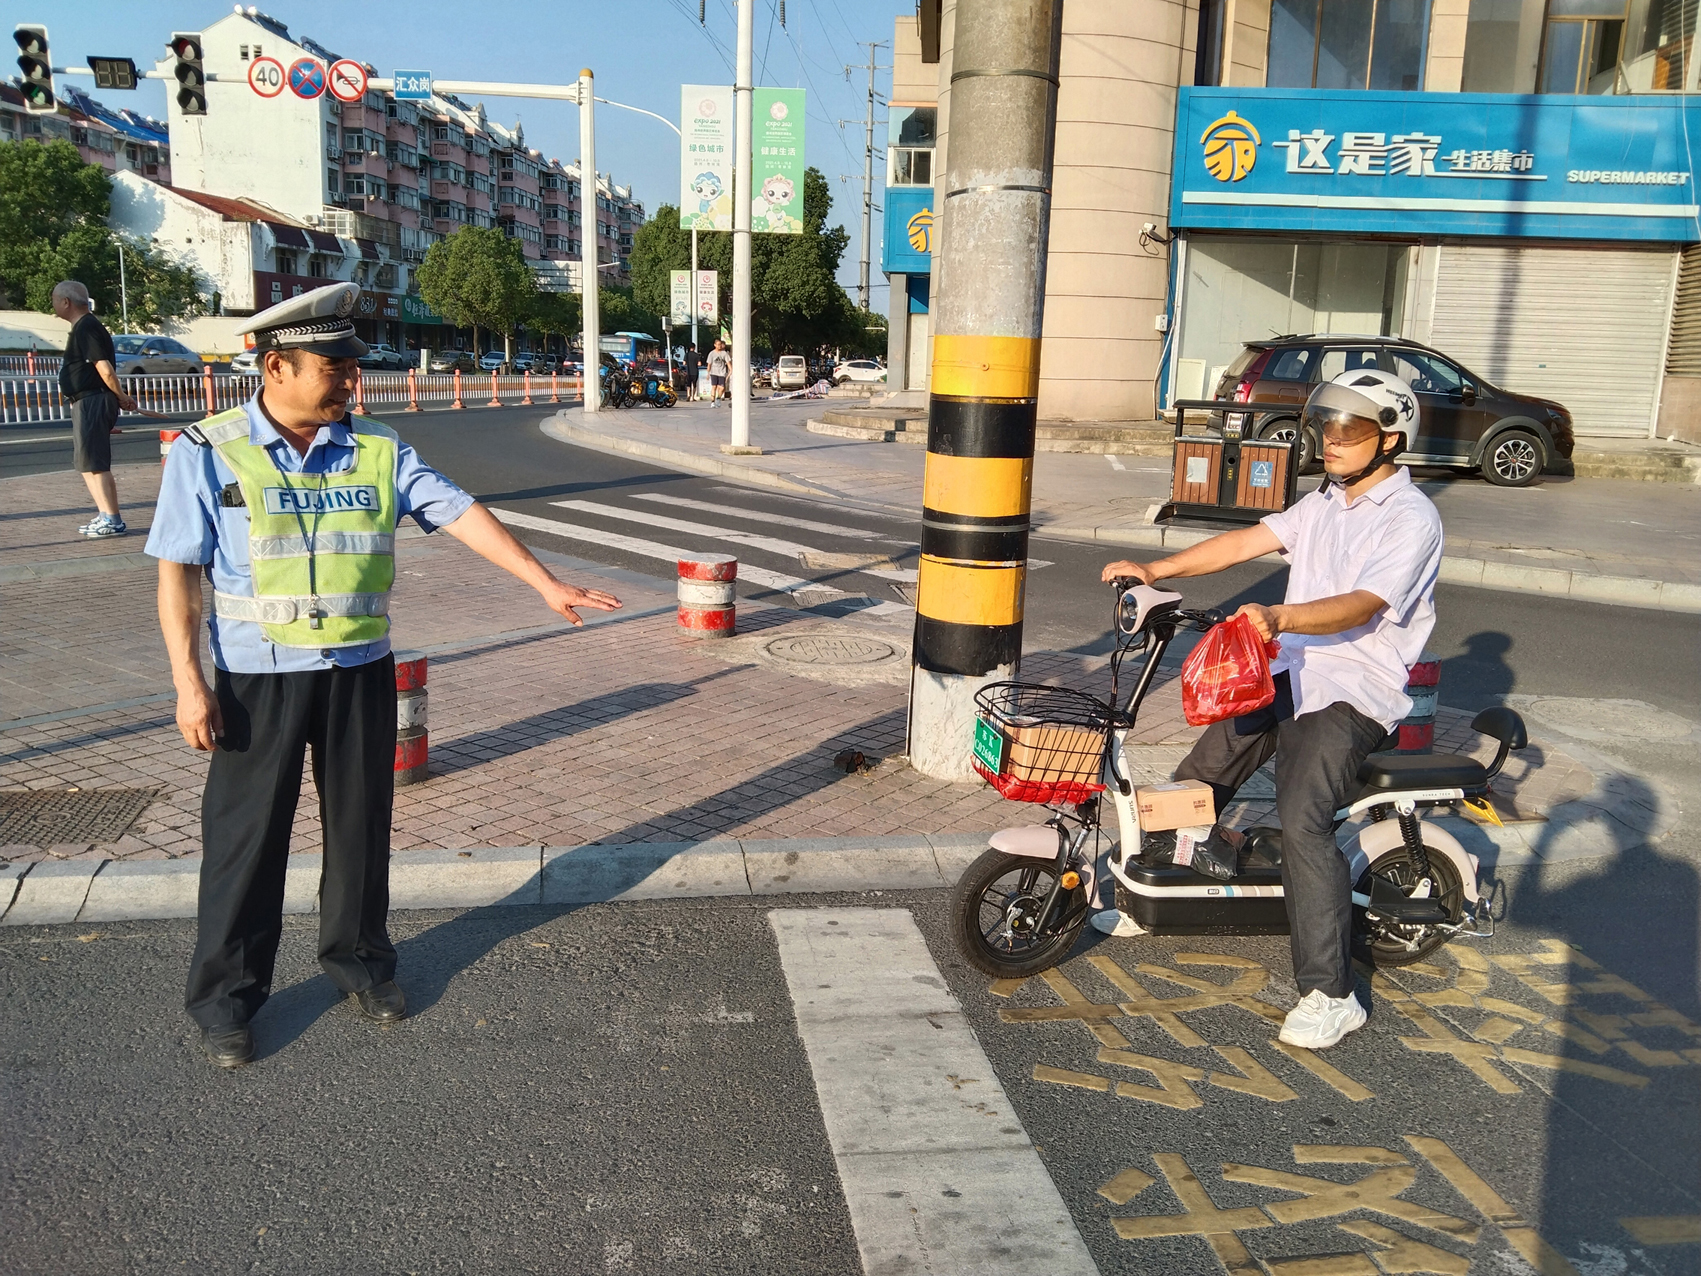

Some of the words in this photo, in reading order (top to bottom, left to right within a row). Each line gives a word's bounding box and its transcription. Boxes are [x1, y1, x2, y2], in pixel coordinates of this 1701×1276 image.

[255, 66, 279, 87] 40
[396, 76, 430, 93] 汇众岗
[689, 144, 724, 153] 绿色城市
[761, 146, 796, 156] 健康生活
[1272, 129, 1444, 178] 这是家
[1441, 149, 1535, 173] 生活集市
[1567, 170, 1690, 186] SUPERMARKET
[278, 489, 371, 509] FUJING
